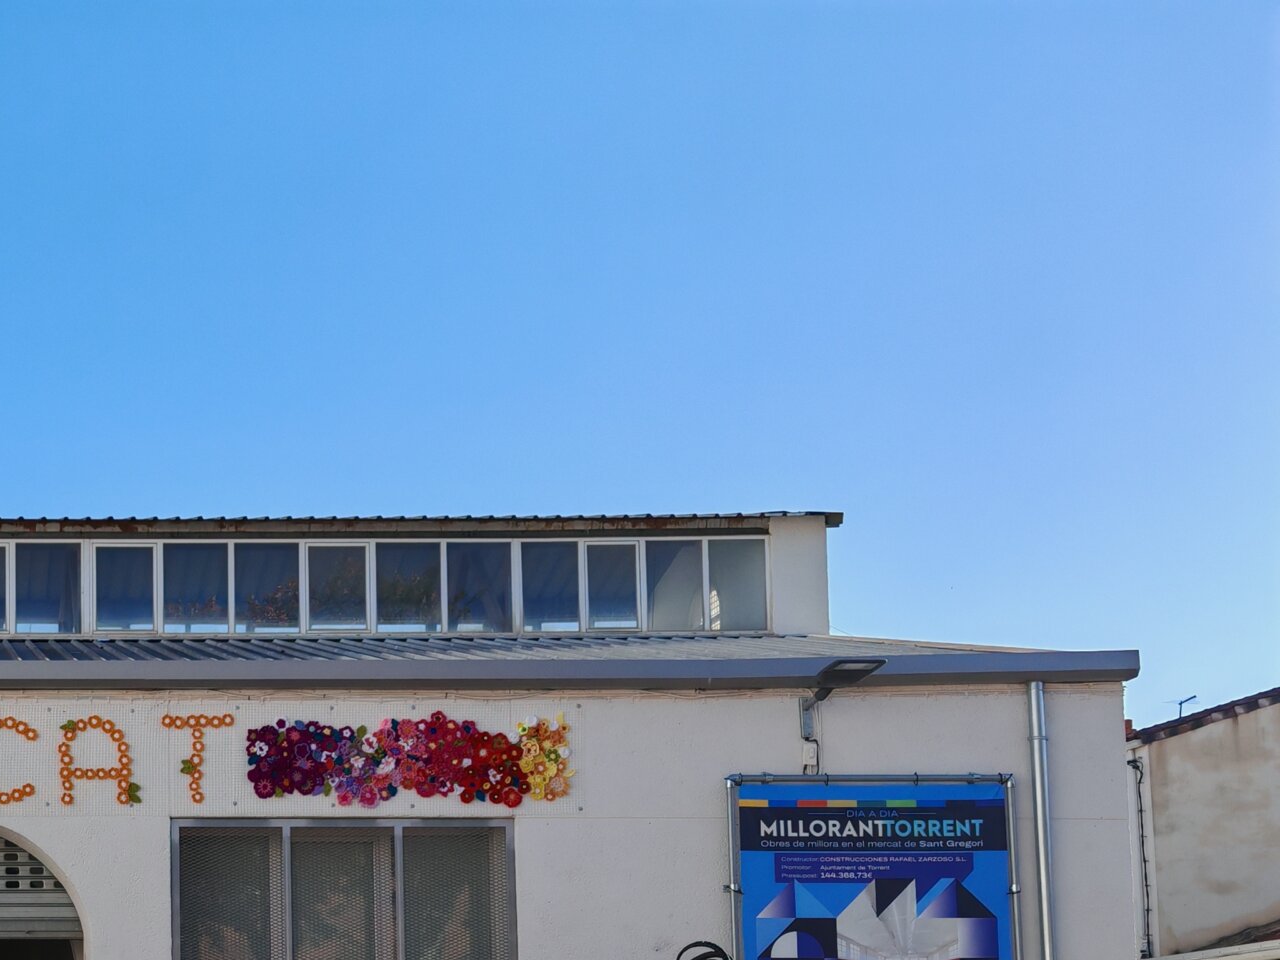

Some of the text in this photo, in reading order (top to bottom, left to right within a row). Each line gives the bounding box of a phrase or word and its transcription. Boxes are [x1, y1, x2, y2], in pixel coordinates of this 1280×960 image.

[846, 810, 899, 818] DIA A DIA
[760, 840, 791, 848] Obres
[792, 840, 805, 848] de
[807, 840, 839, 848] millora
[856, 840, 865, 848] el
[867, 840, 902, 848] mercat
[904, 840, 917, 848] de
[919, 840, 945, 848] Sant
[946, 839, 984, 849] Gregori
